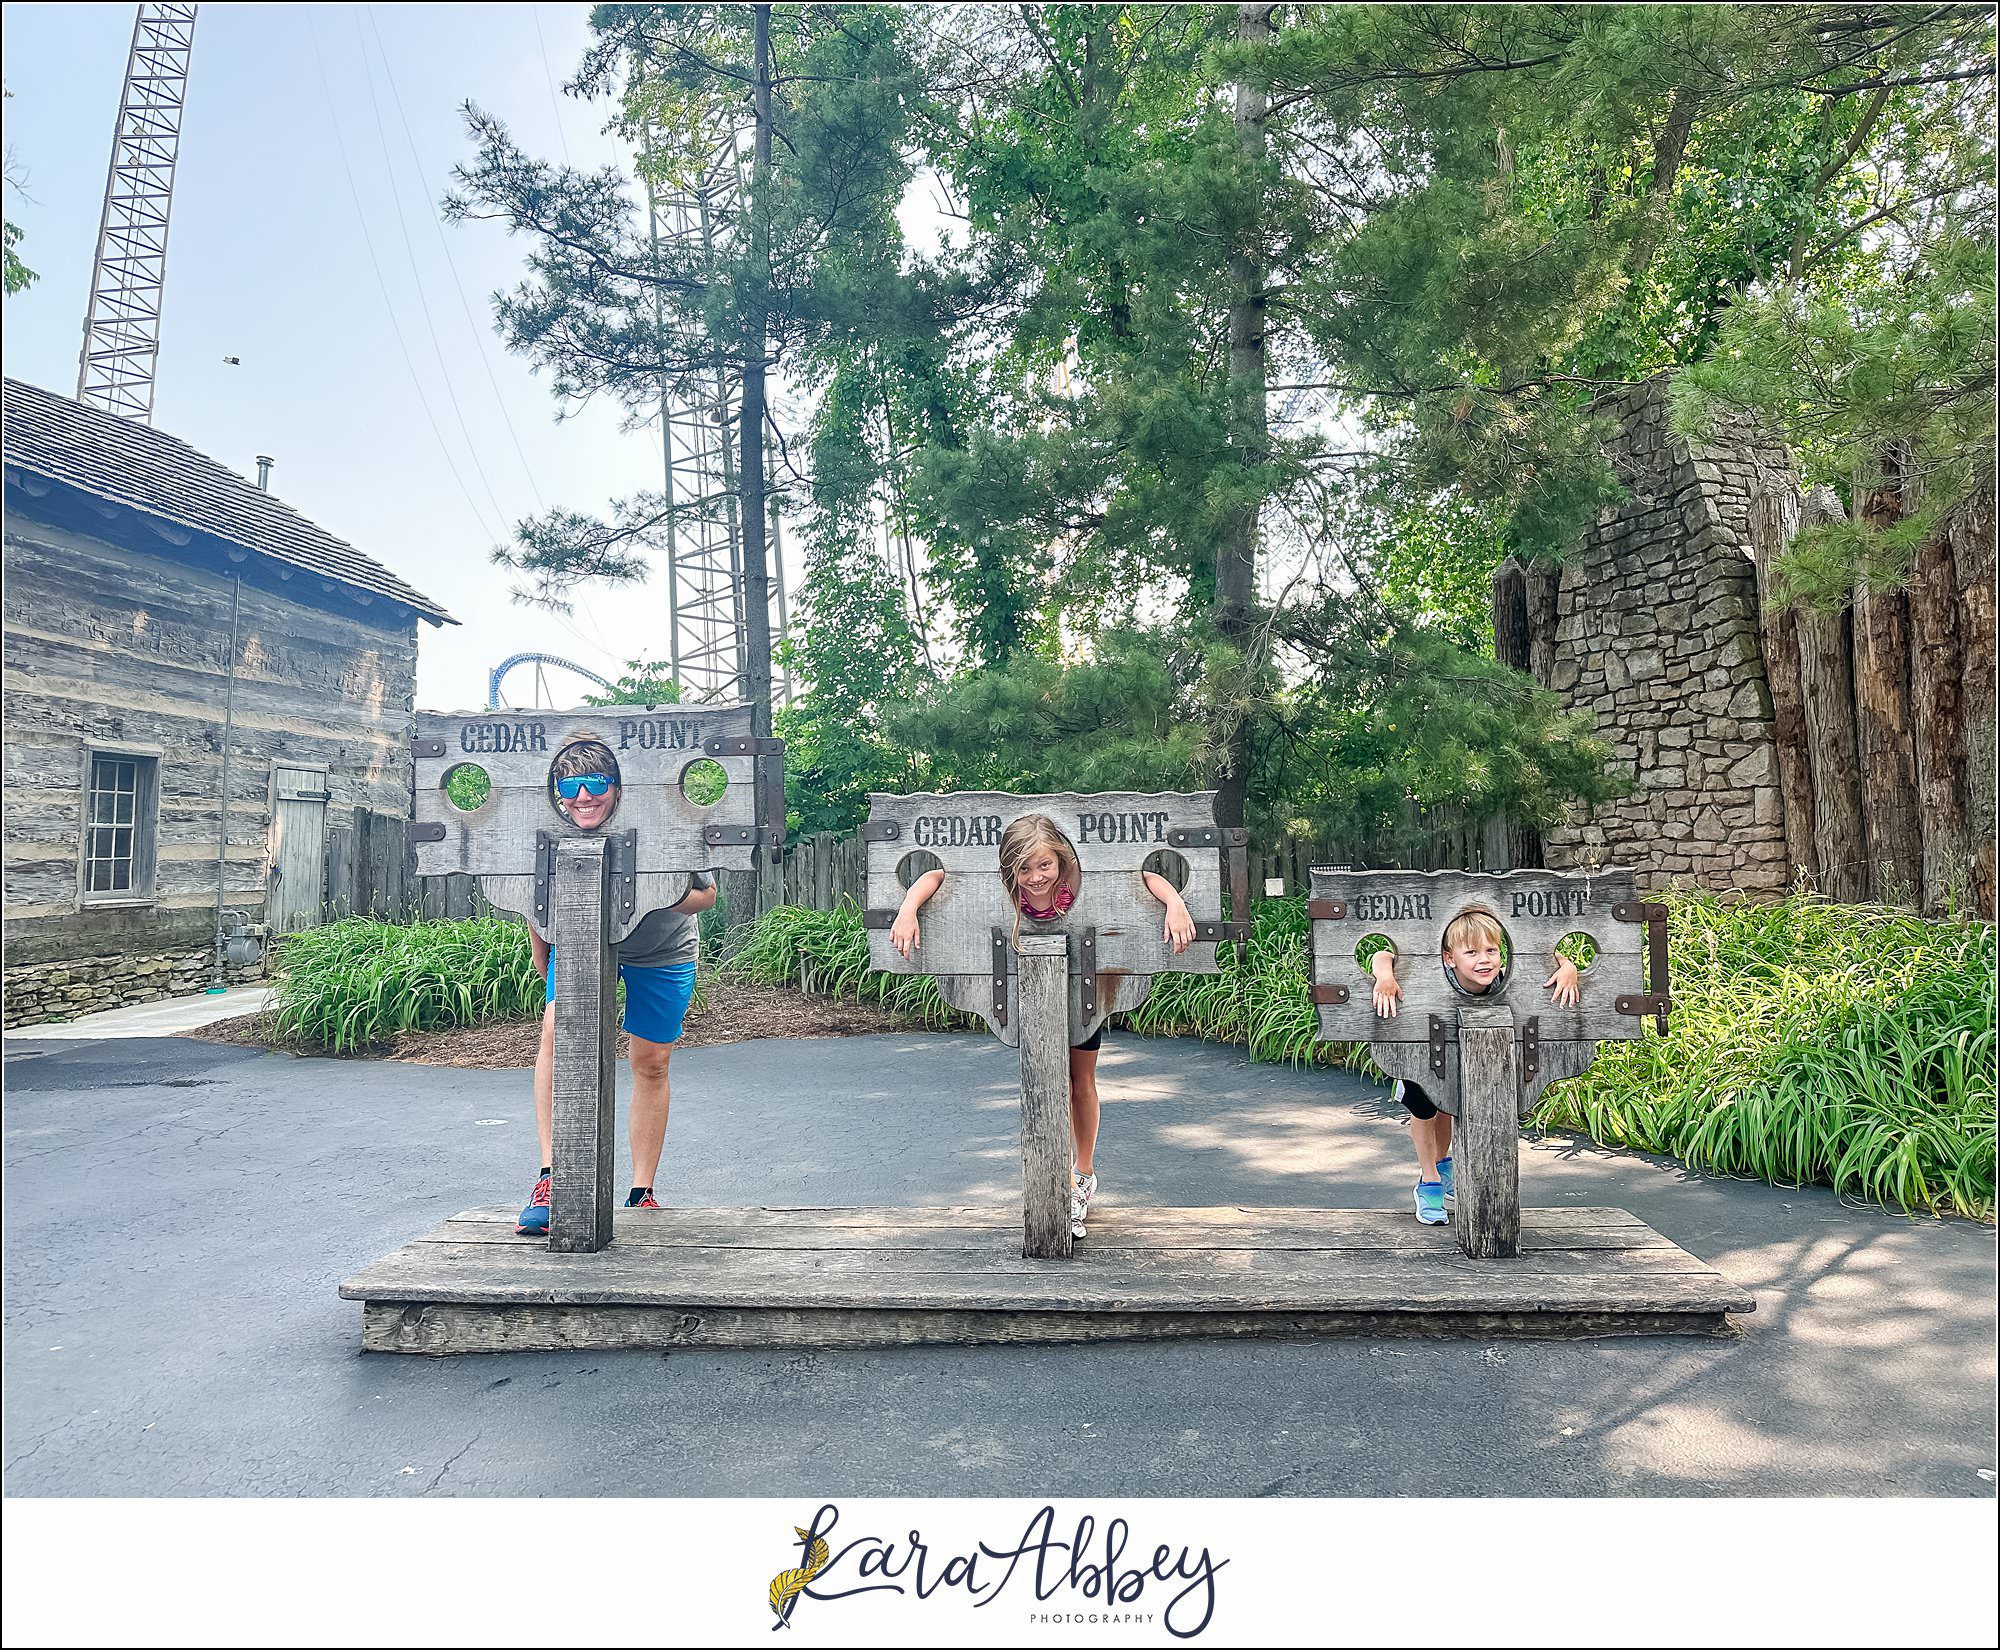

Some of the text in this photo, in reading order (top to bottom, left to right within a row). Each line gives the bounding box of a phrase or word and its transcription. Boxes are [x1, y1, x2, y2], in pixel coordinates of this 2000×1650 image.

[460, 719, 705, 753] CEDAR POINT
[914, 812, 1169, 847] CEDAR POINT
[1354, 890, 1589, 922] CEDAR POINT
